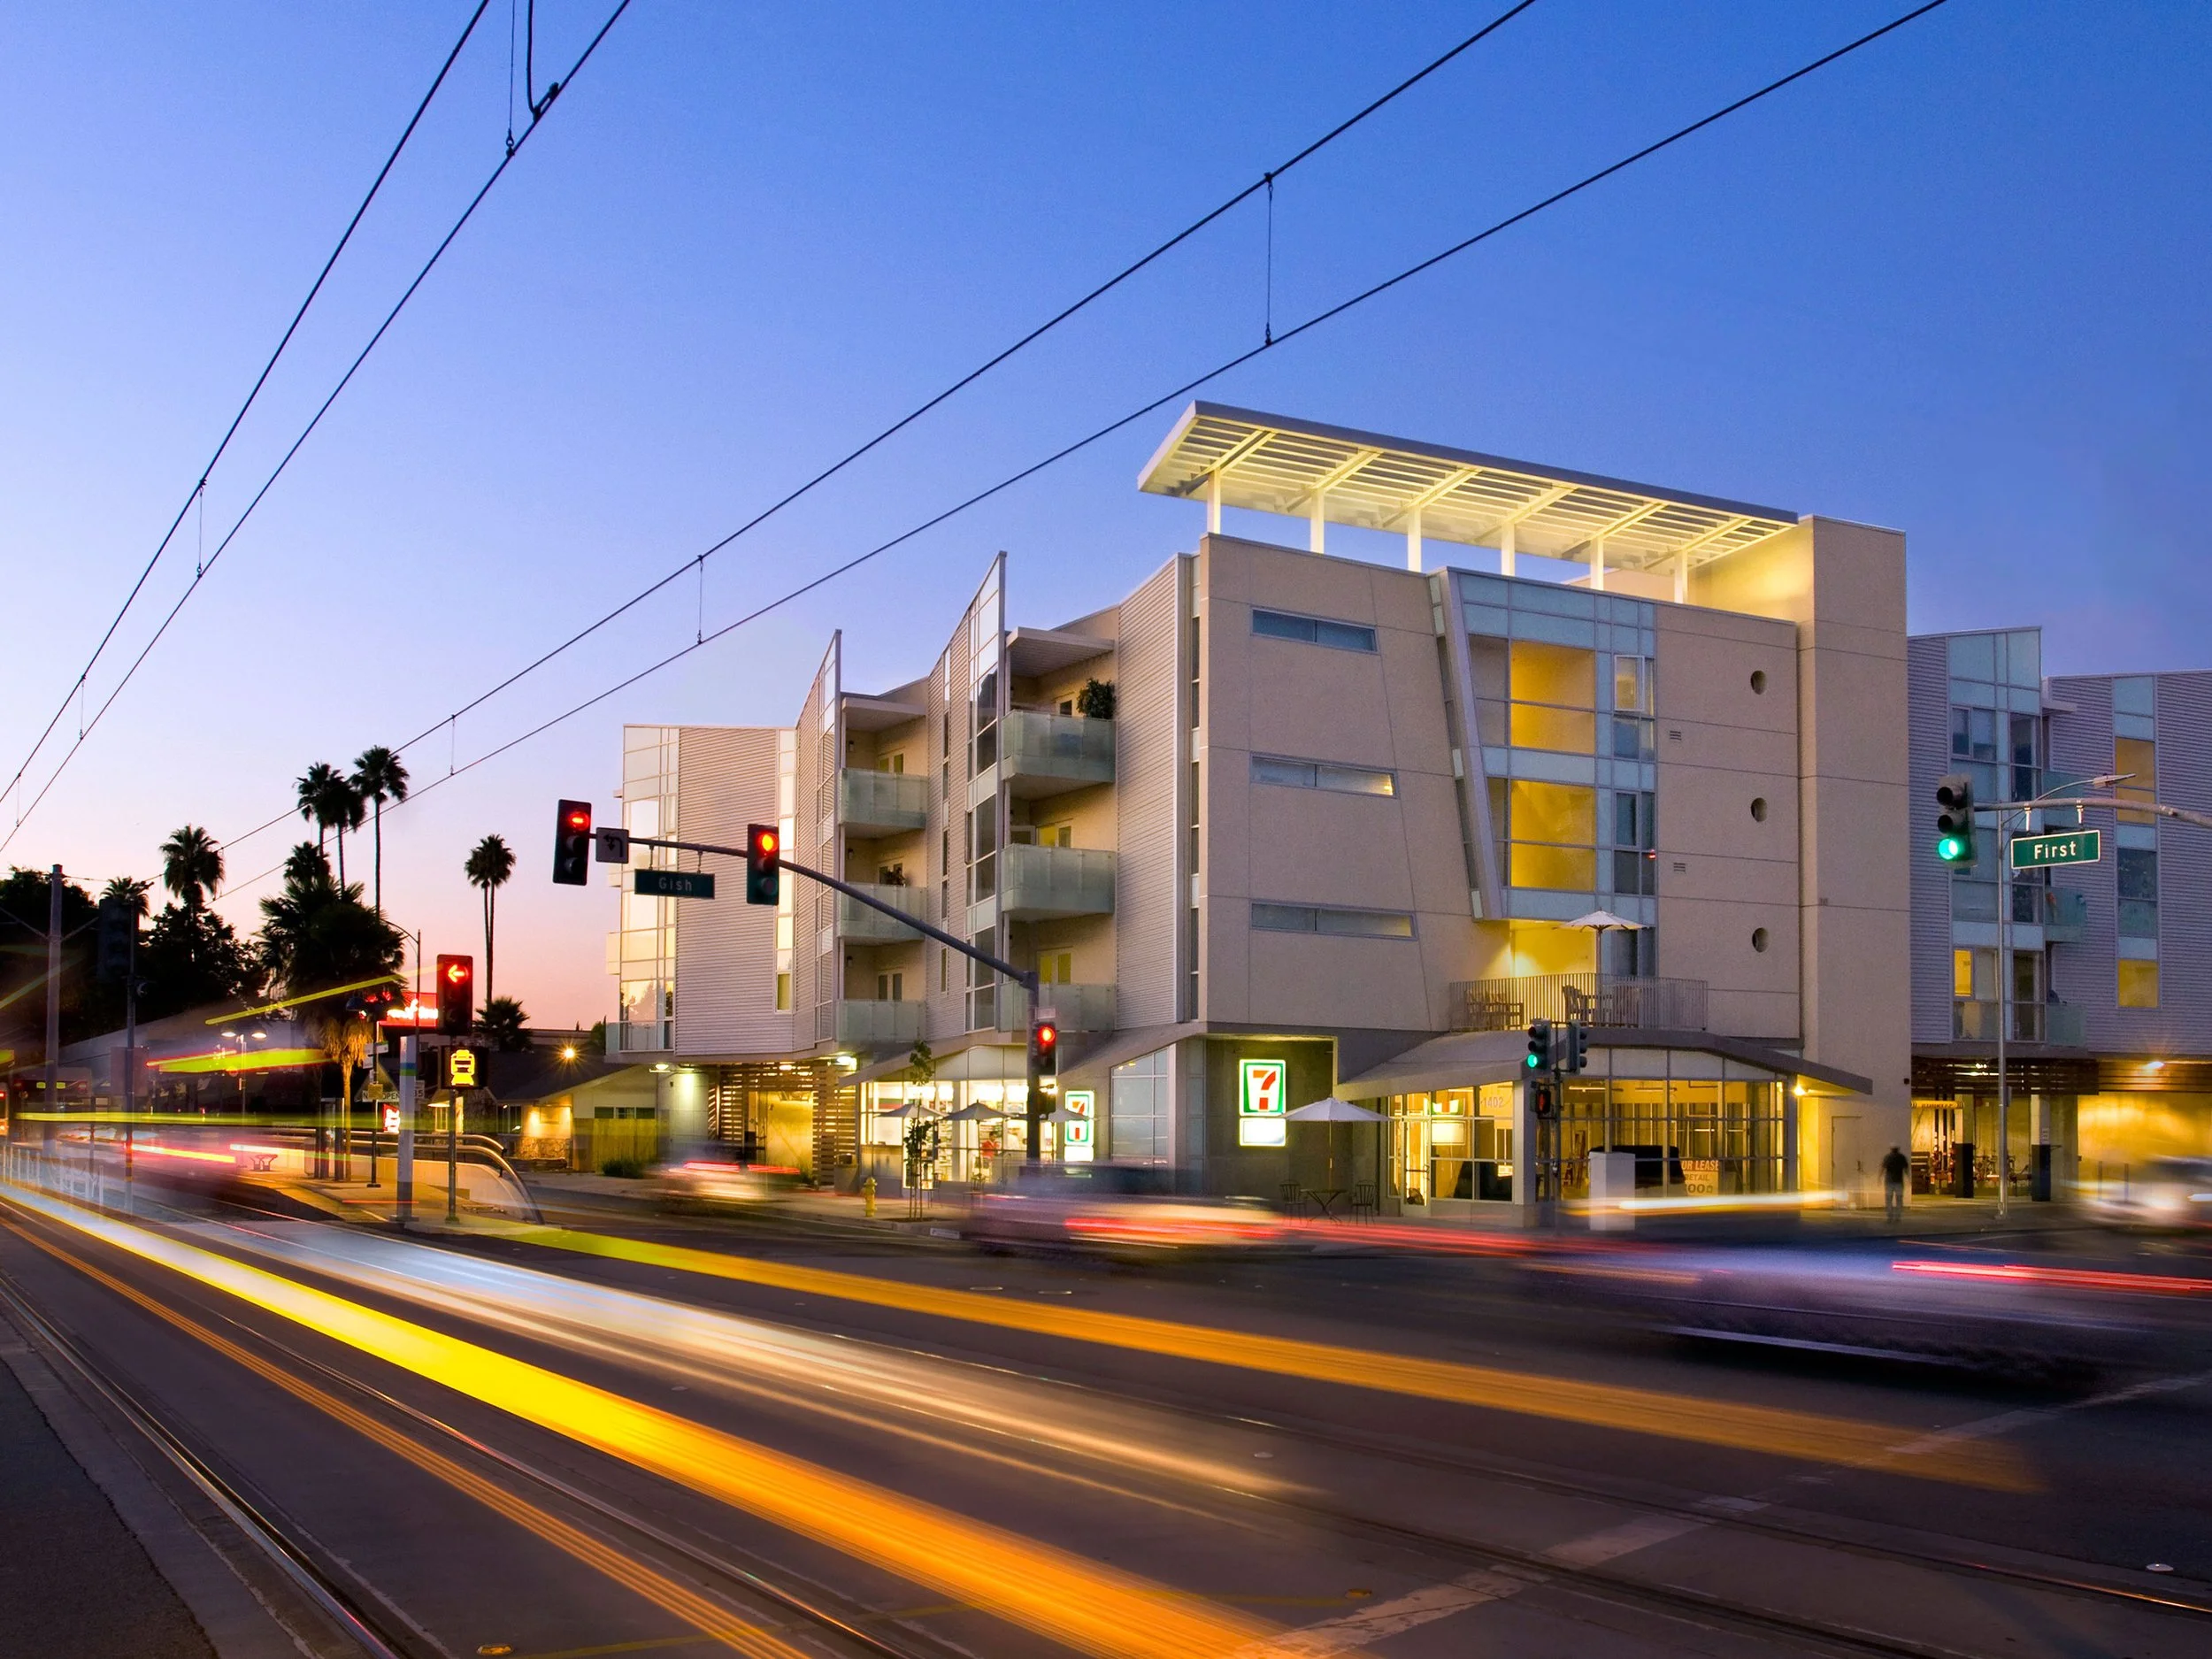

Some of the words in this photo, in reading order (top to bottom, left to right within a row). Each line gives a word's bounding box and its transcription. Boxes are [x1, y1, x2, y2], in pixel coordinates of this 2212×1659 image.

[2034, 841, 2077, 859] First
[658, 877, 692, 892] Gish
[1253, 1070, 1277, 1110] 7
[1695, 1160, 1718, 1171] LEASE
